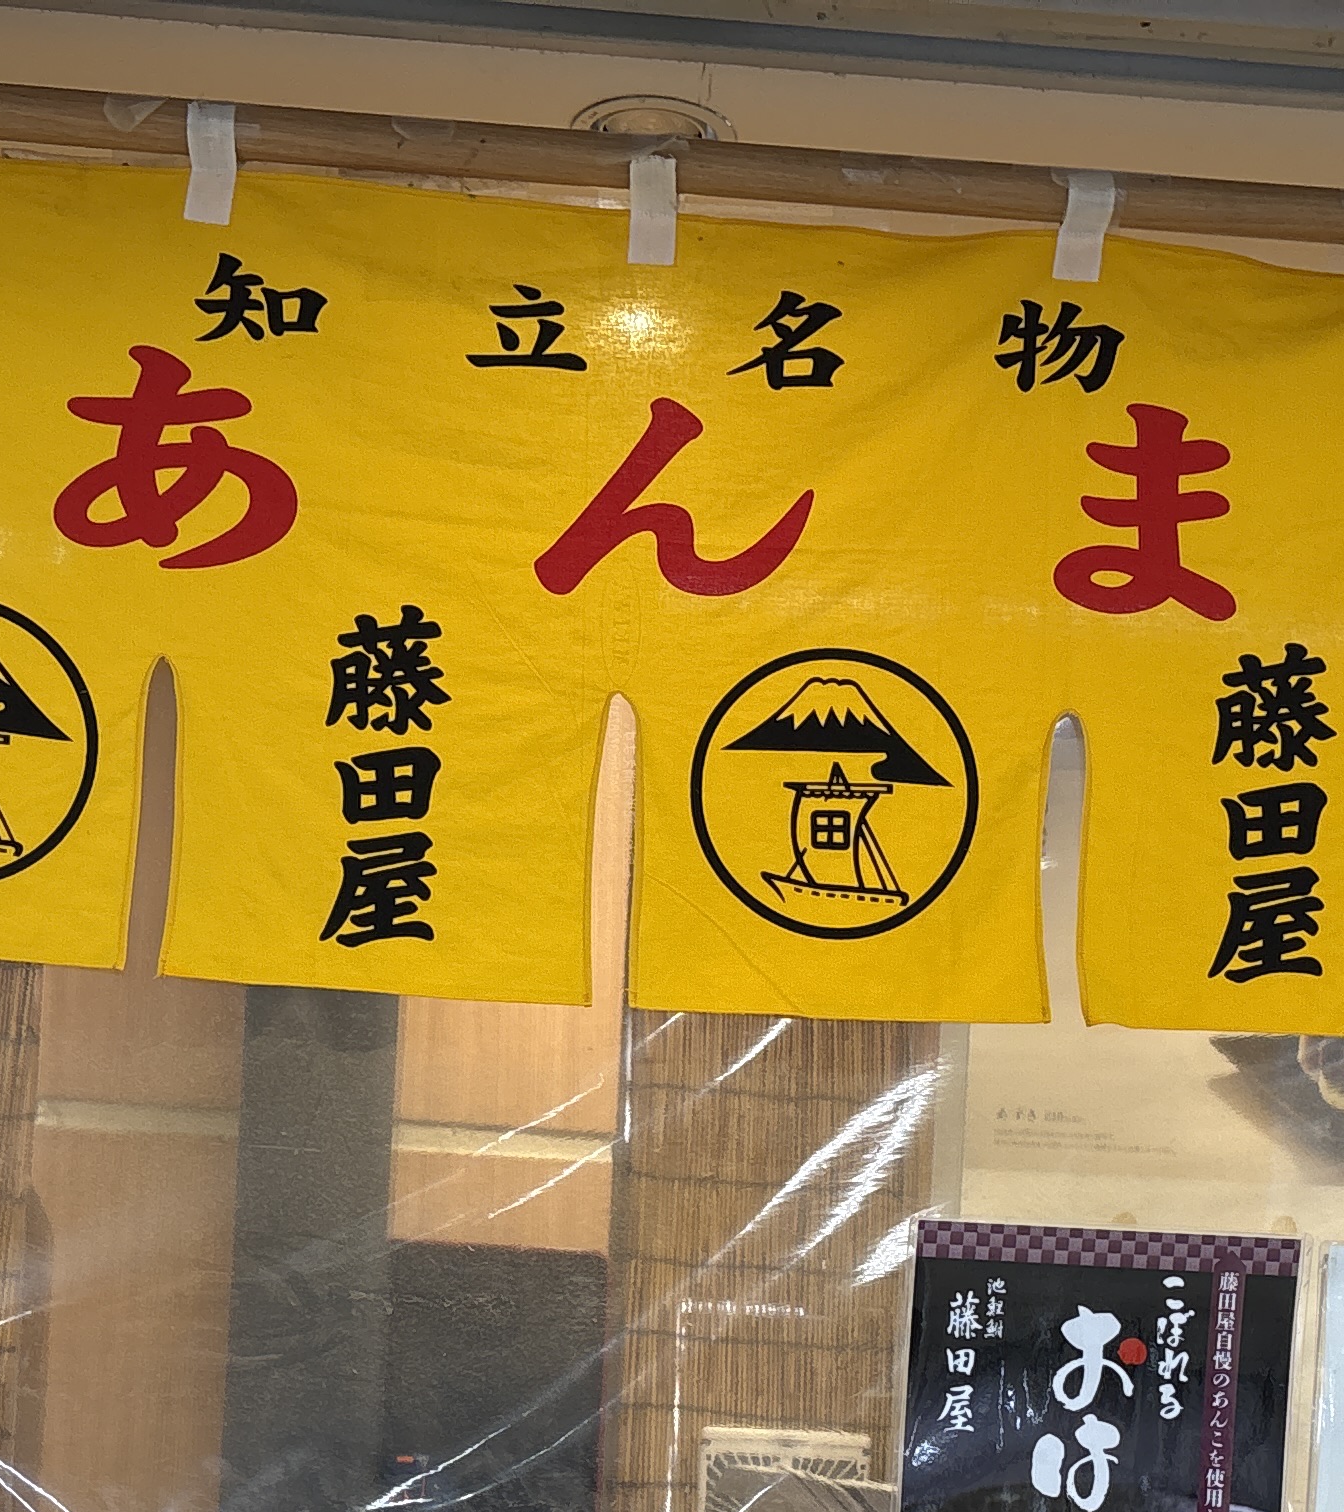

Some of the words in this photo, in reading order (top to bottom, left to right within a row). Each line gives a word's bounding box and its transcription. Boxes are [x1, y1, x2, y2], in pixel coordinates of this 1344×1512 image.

[194, 251, 1126, 396] 知立名物
[320, 604, 453, 949] 藤田屋
[1208, 642, 1338, 984] 藤田屋
[937, 1291, 982, 1433] 藤田屋
[1156, 1275, 1195, 1420] こぼれる
